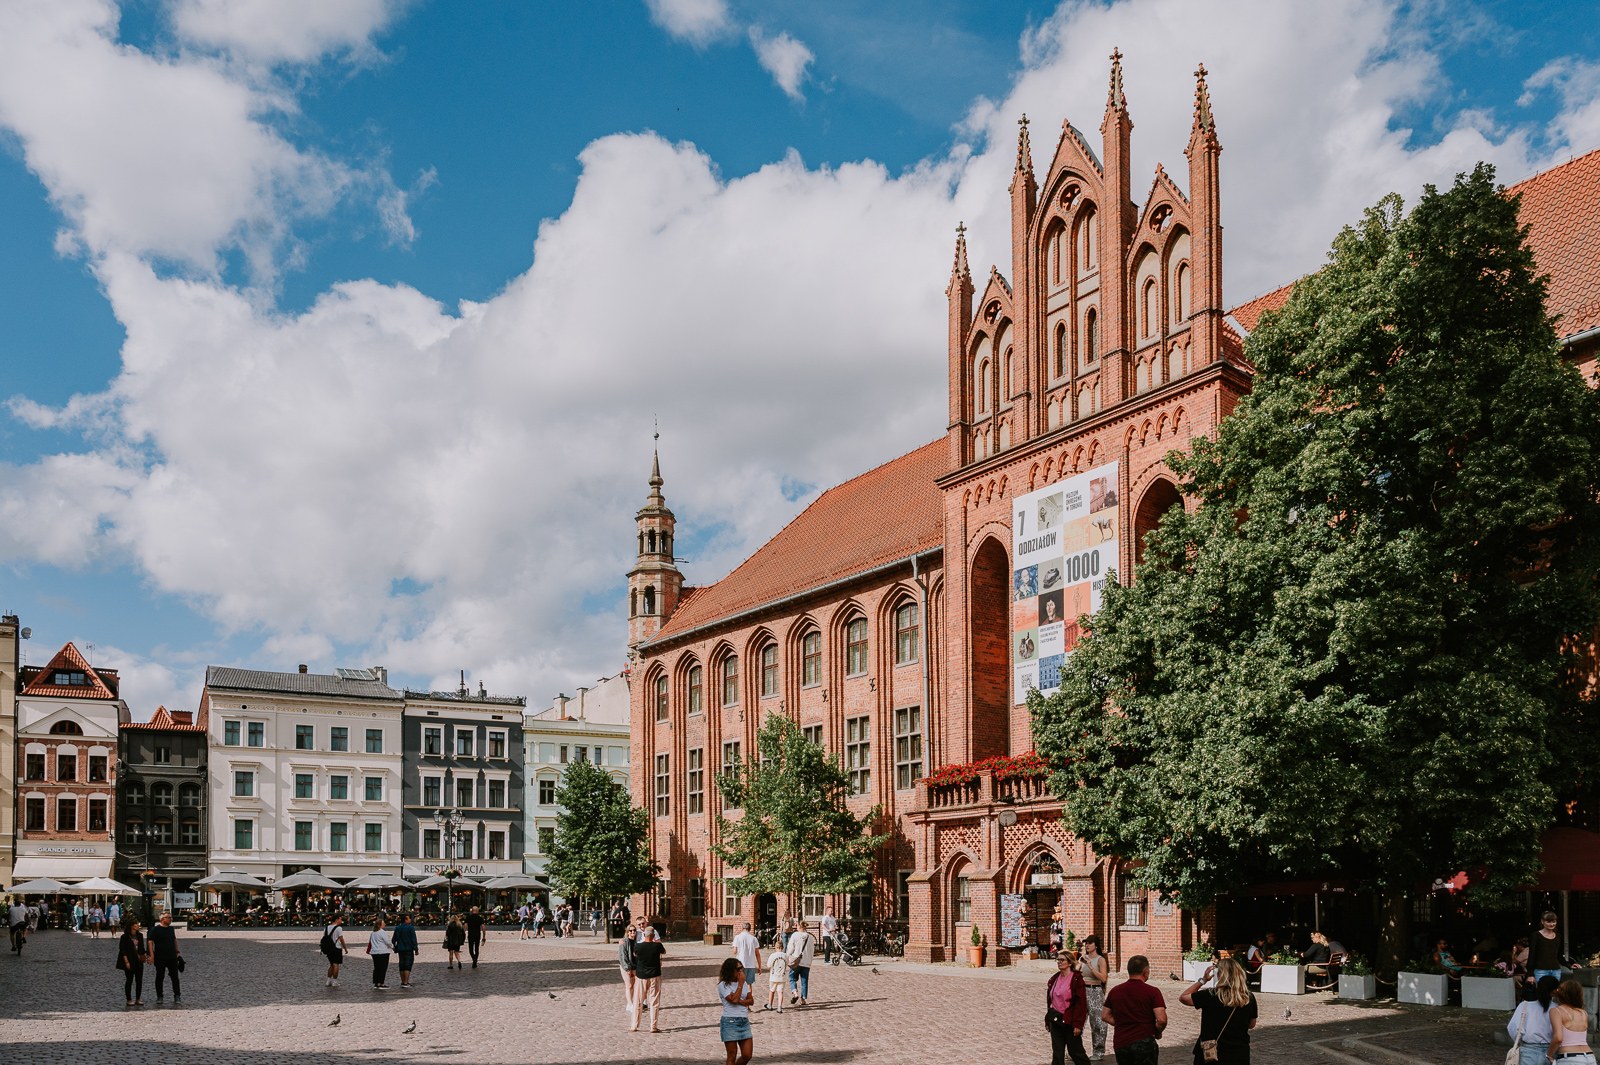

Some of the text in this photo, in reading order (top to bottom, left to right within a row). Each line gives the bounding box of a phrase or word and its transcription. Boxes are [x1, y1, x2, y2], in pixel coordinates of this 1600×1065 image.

[1018, 510, 1025, 536] 7
[1018, 531, 1057, 556] ODDZIAŁÓW
[1066, 549, 1100, 583] 1000
